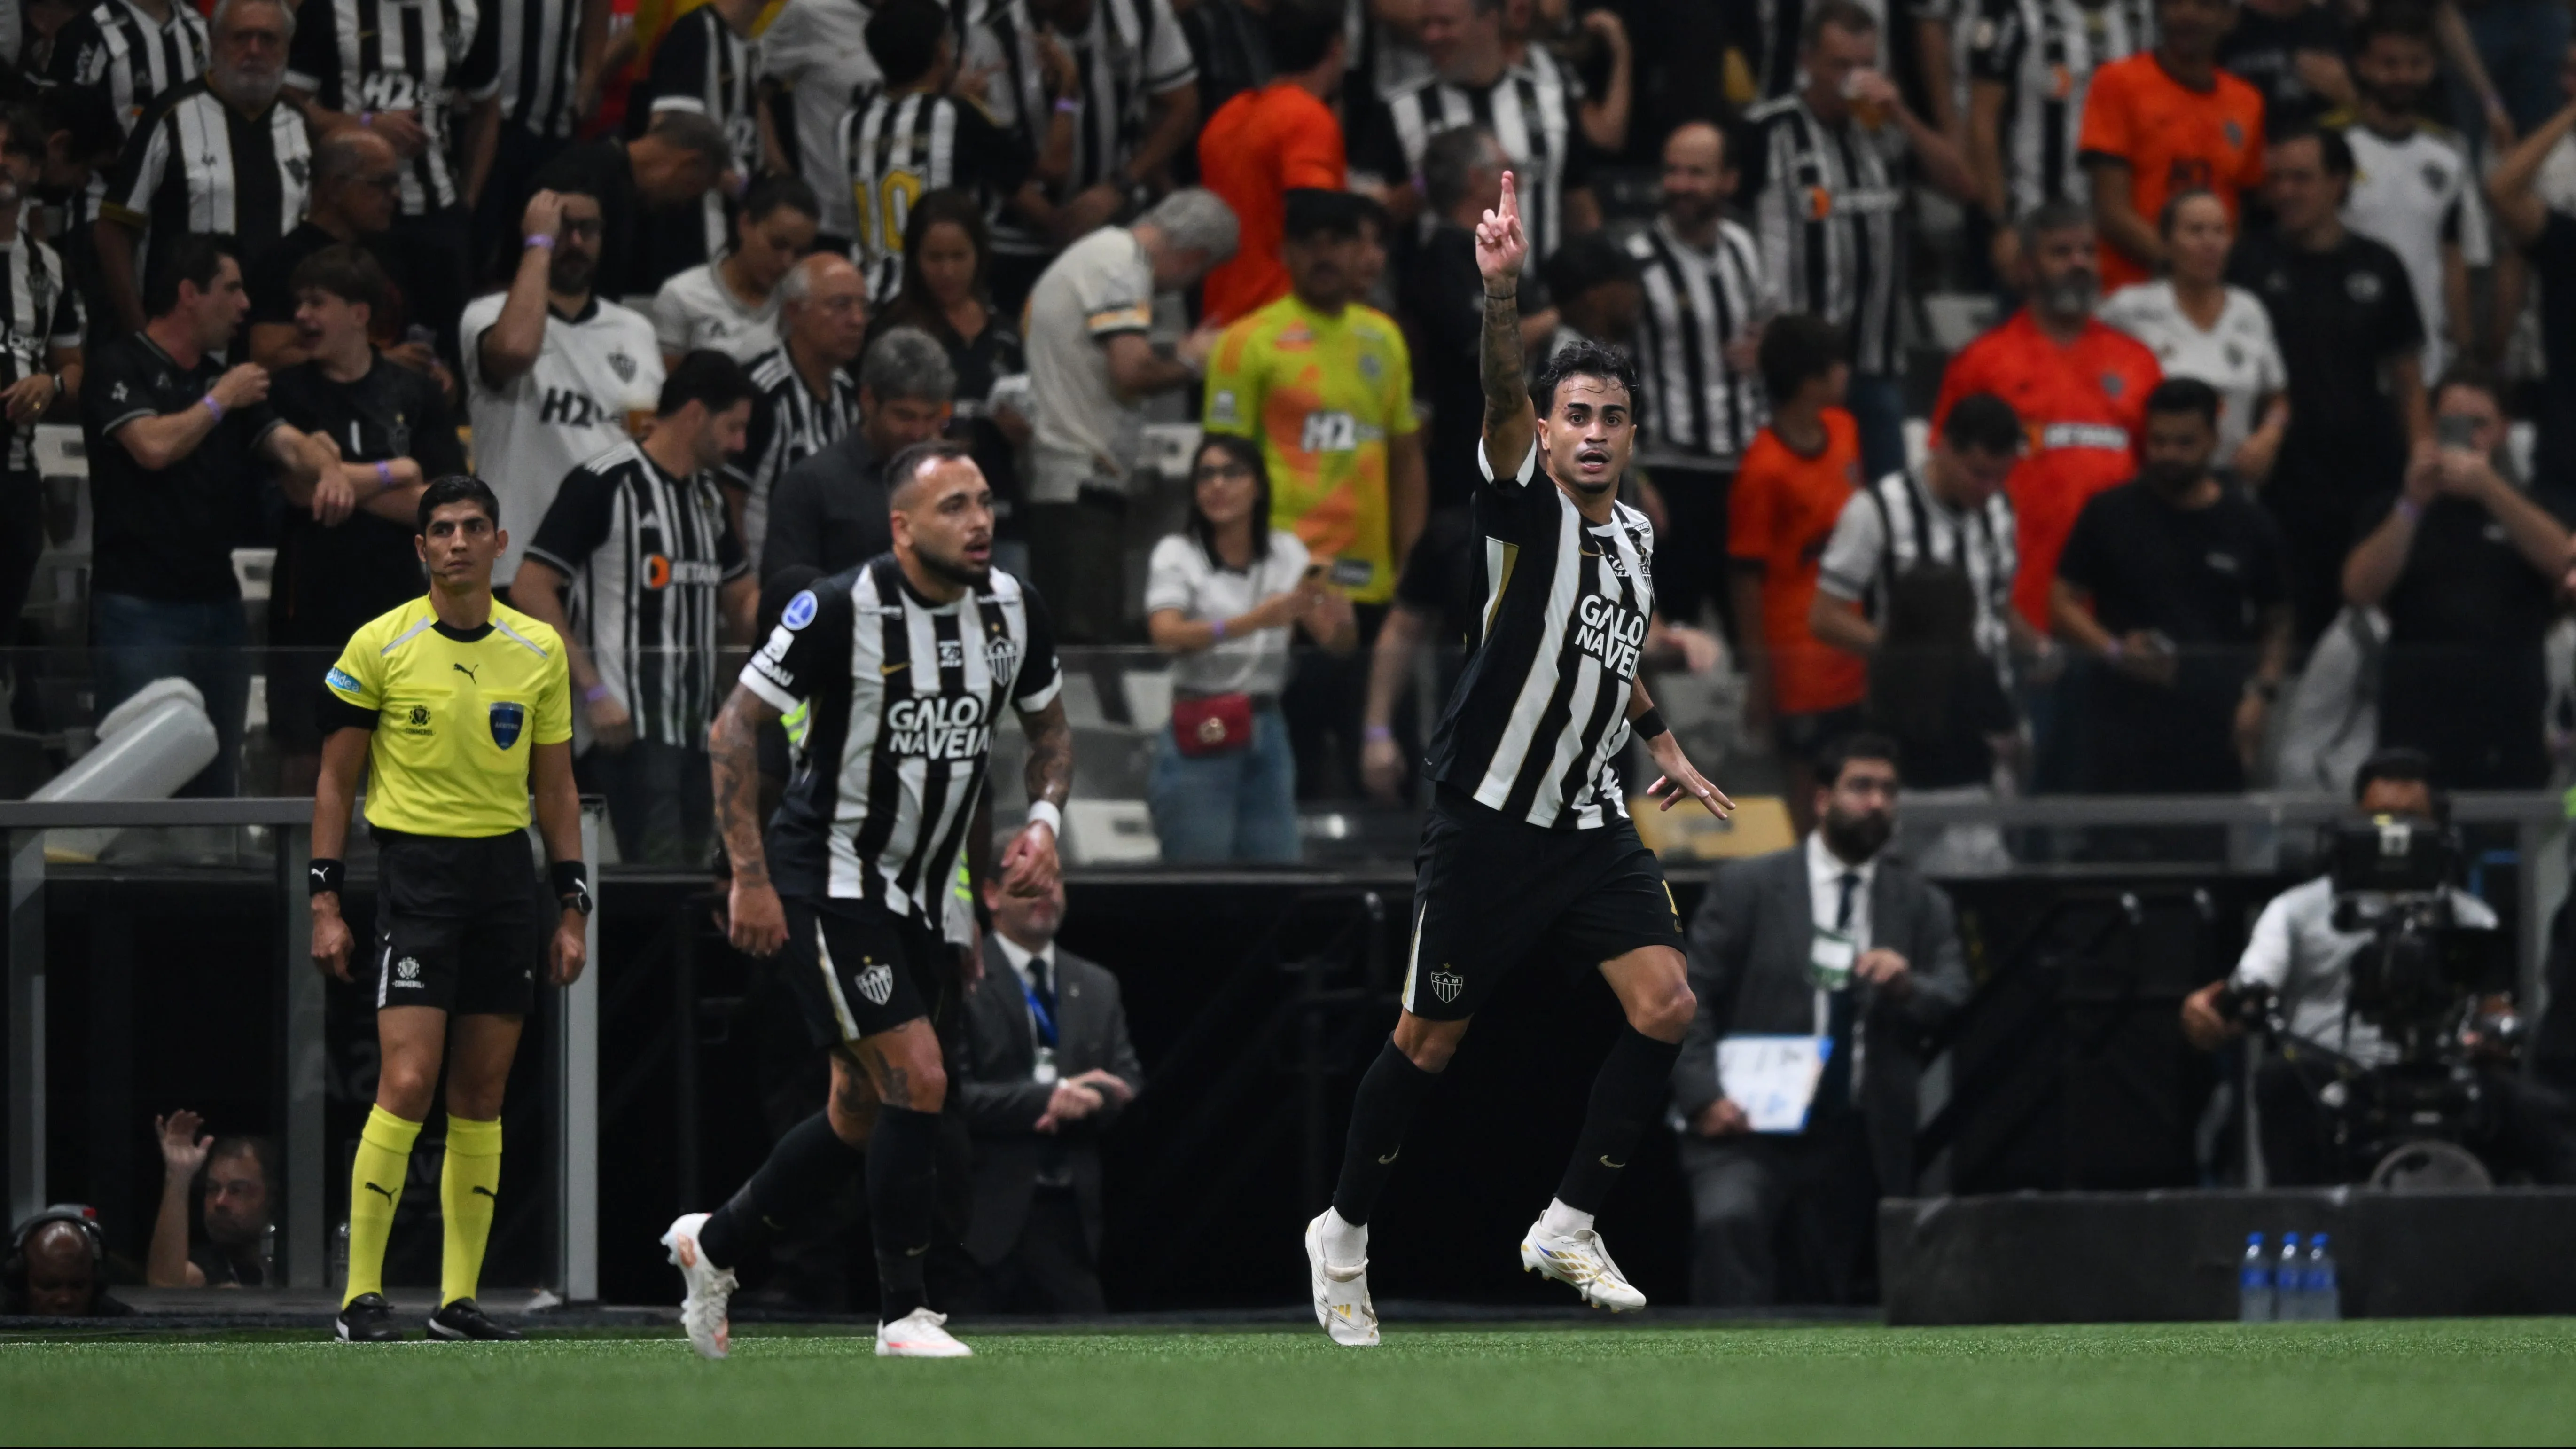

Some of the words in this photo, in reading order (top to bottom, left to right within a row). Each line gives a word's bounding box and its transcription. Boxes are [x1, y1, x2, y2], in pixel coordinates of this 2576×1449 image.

[1580, 595, 1644, 646] GALO
[888, 696, 979, 731] GALO
[1435, 975, 1460, 984] CAM
